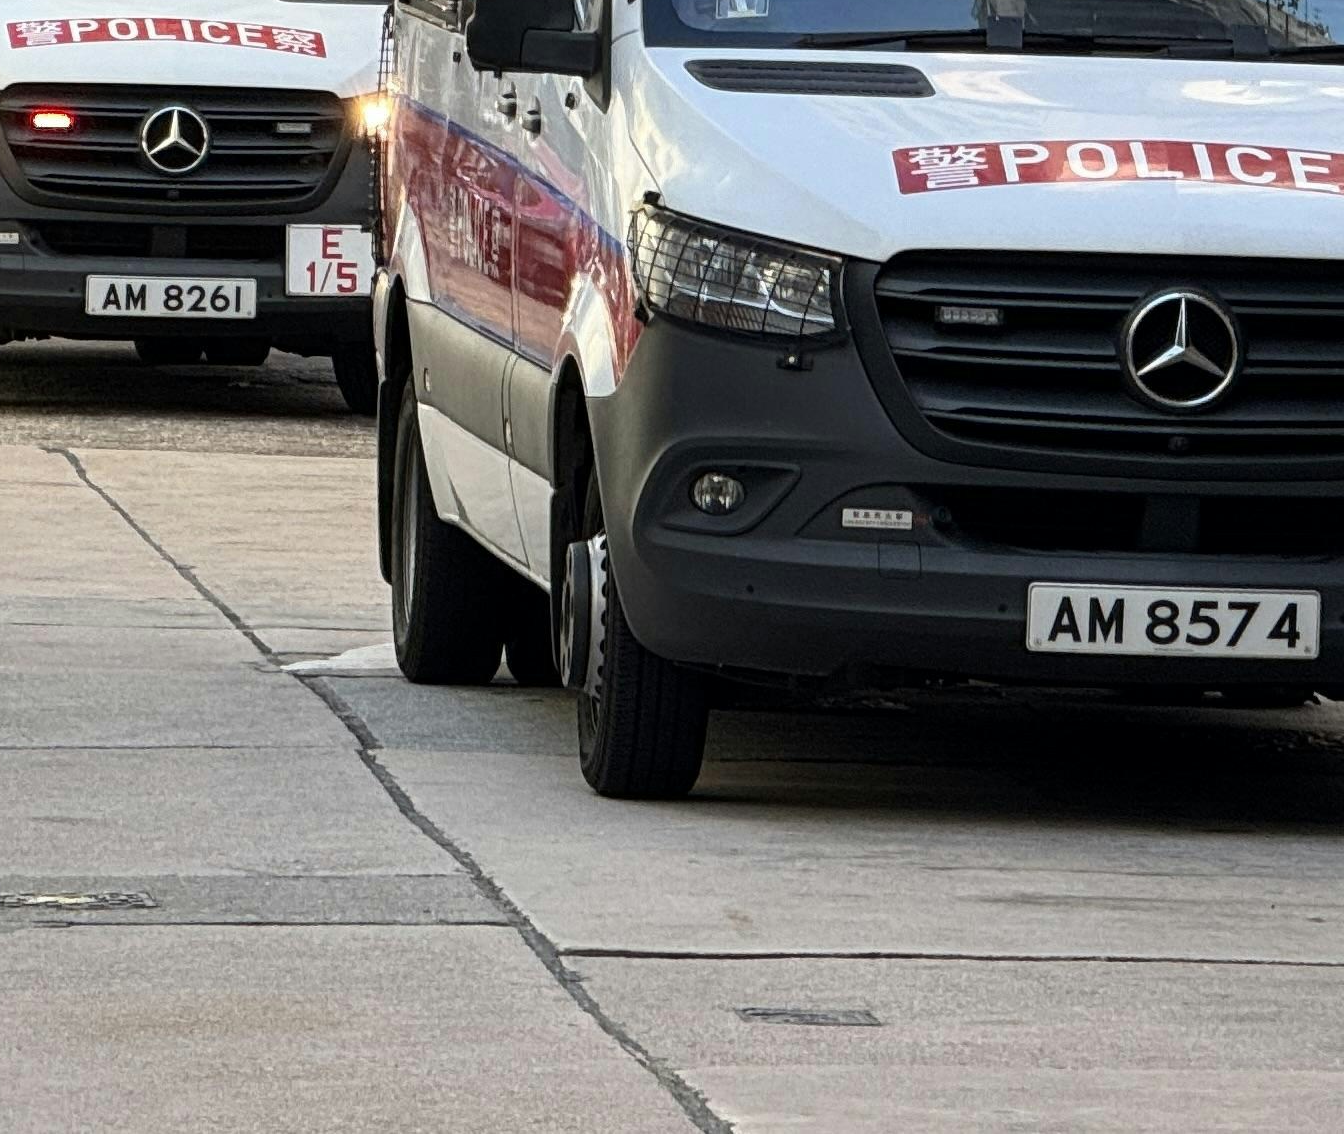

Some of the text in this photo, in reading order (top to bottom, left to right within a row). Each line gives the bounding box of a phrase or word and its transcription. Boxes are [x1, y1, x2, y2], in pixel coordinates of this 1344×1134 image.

[68, 18, 268, 49] POLICE
[909, 146, 988, 189] 警
[999, 141, 1342, 192] POLICE
[321, 229, 343, 260] E
[306, 261, 358, 293] 1/5
[102, 284, 242, 313] AM 8261
[1048, 596, 1301, 647] AM 8574
